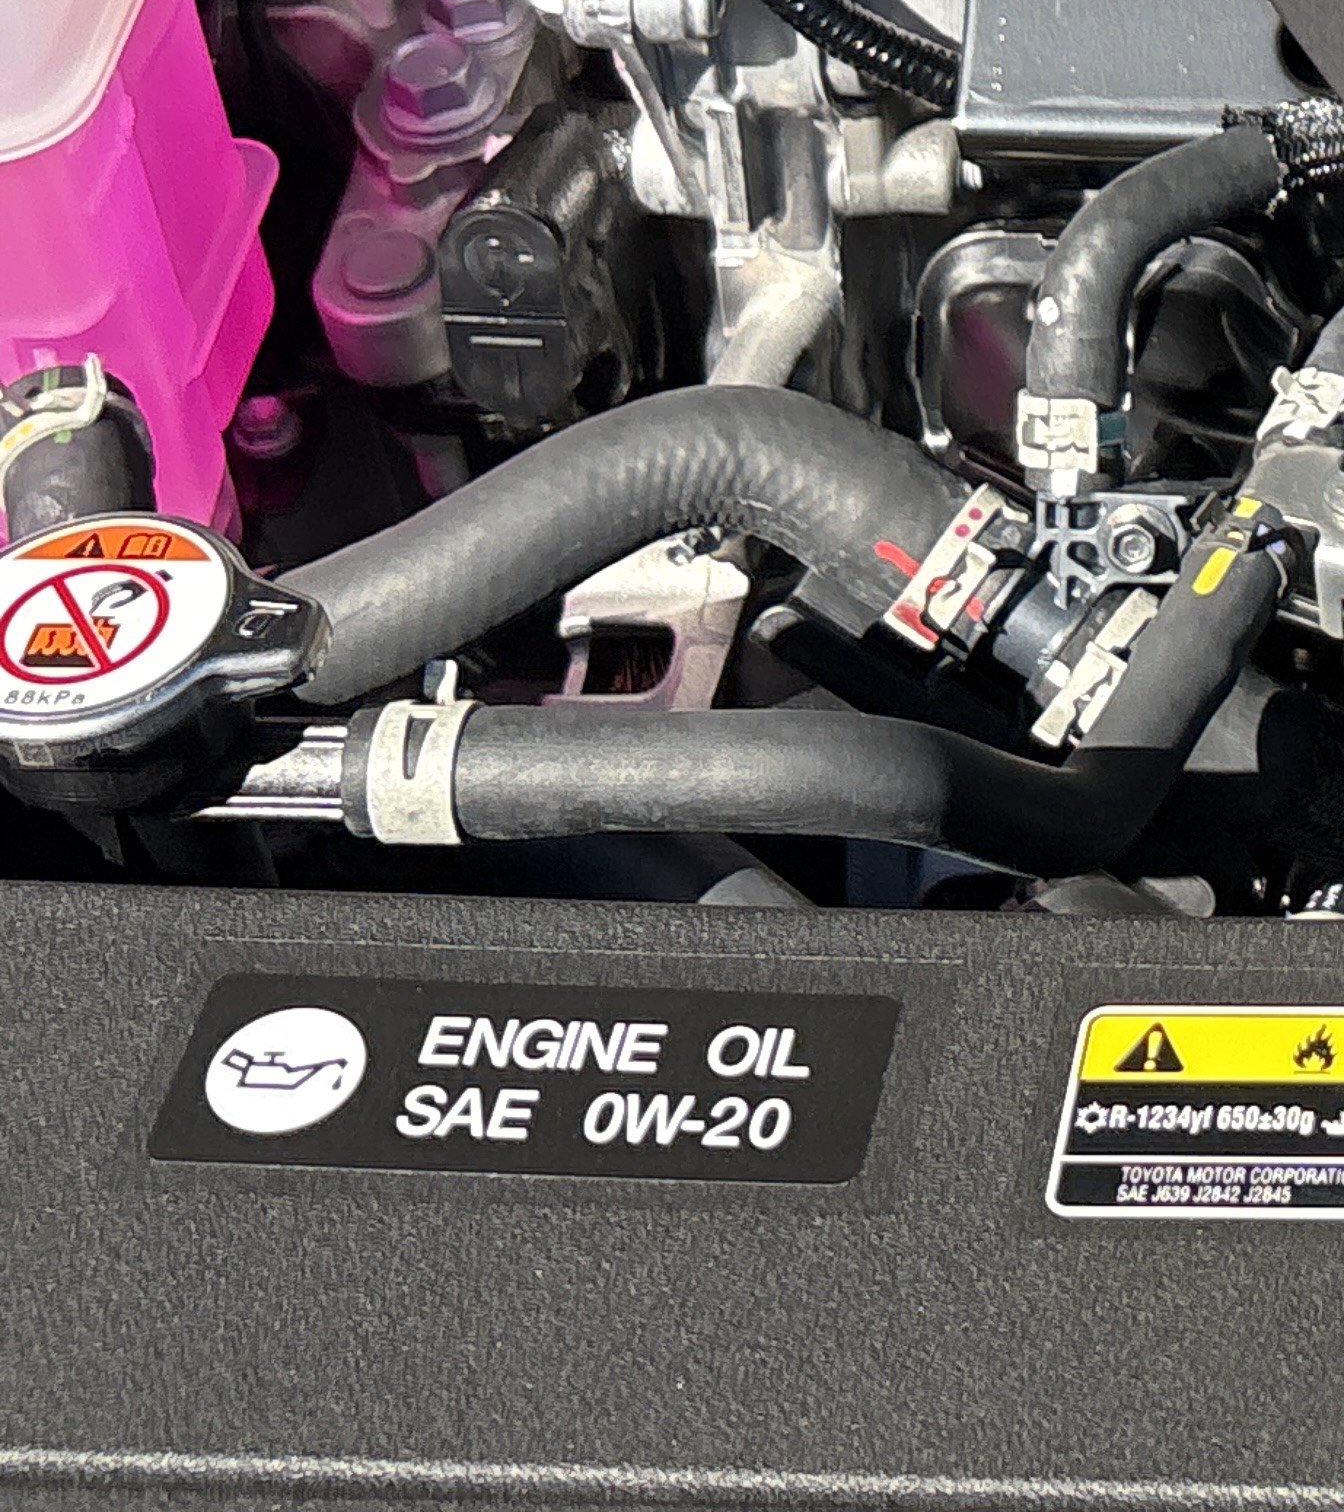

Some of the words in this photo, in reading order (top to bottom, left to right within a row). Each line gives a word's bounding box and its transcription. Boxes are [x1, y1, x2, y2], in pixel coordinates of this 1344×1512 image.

[4, 690, 85, 705] 88kPa
[418, 1016, 668, 1073] ENGINE
[707, 1024, 810, 1079] OIL
[396, 1085, 540, 1140] SAE
[583, 1092, 791, 1150] 0W-20
[1108, 1104, 1214, 1135] R-1234yf
[1216, 1105, 1315, 1135] 650±30g
[1121, 1166, 1183, 1184] TOYOTA
[1187, 1167, 1246, 1185] MOTOR
[1116, 1184, 1149, 1202] SAE
[1151, 1185, 1190, 1203] J639
[1193, 1185, 1239, 1203] J2842
[1243, 1186, 1292, 1204] J2845
